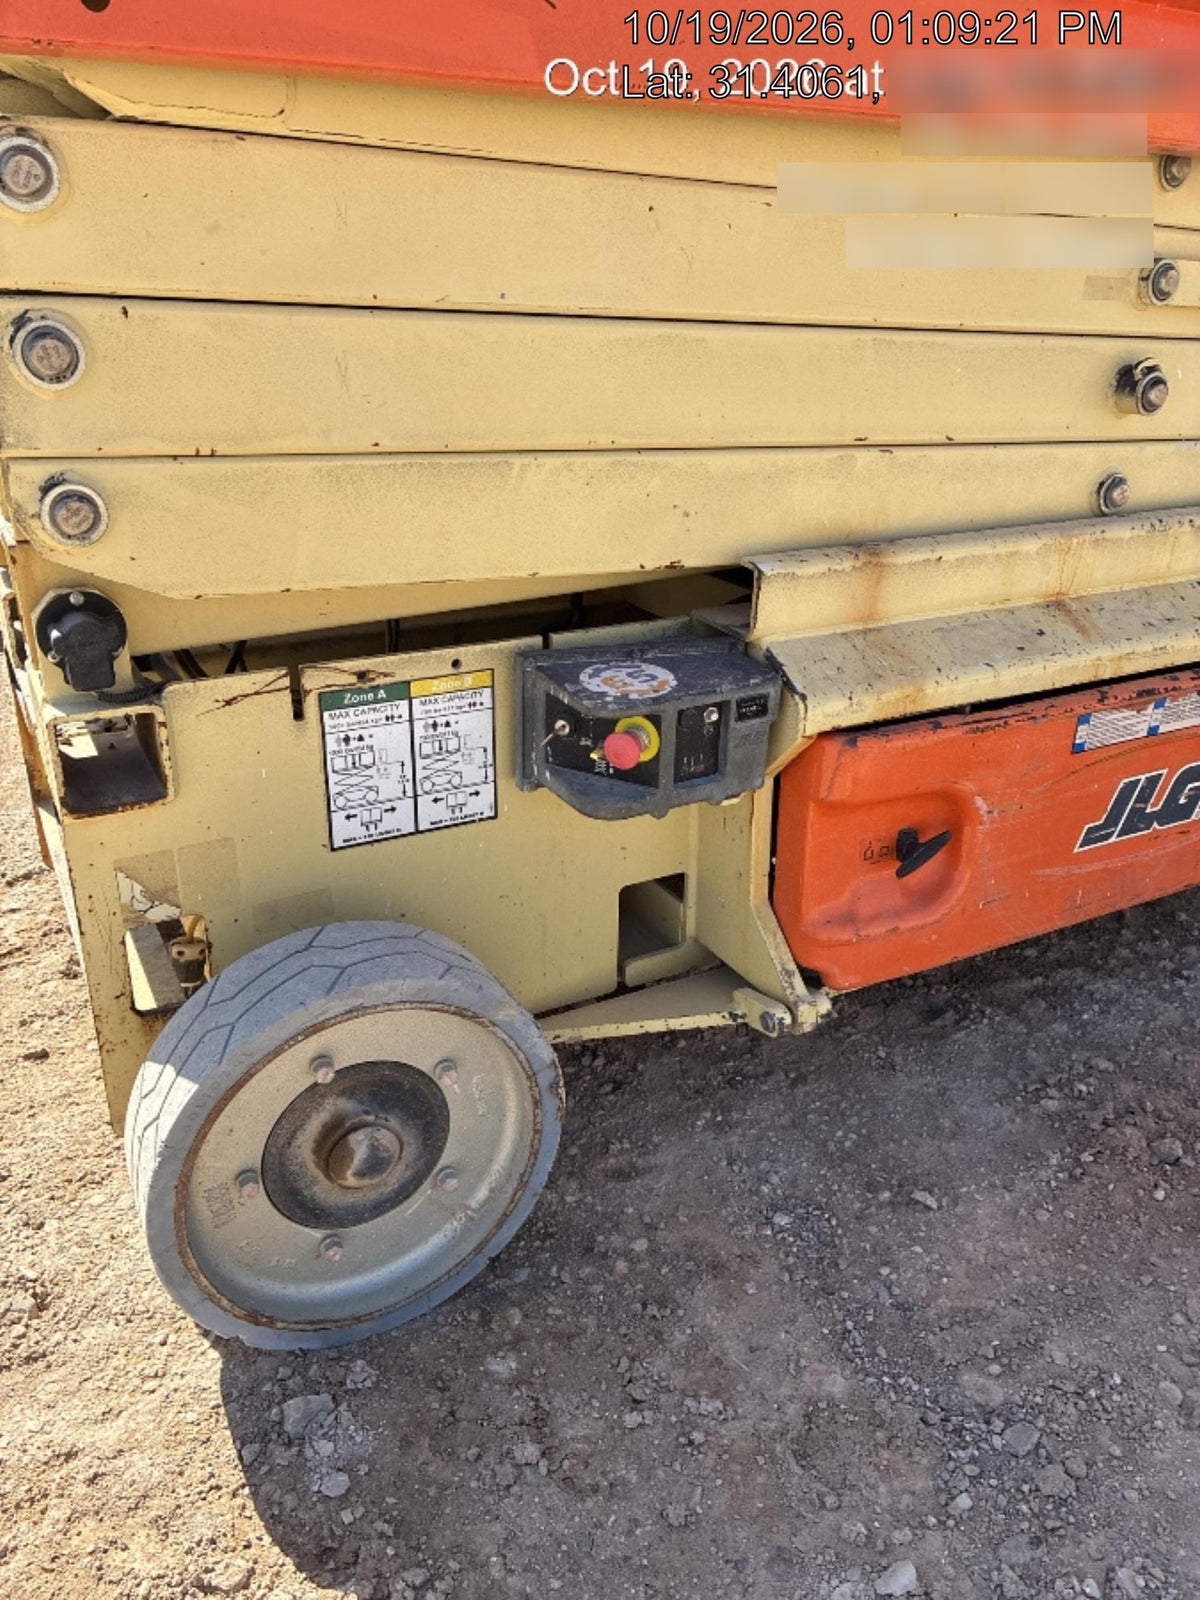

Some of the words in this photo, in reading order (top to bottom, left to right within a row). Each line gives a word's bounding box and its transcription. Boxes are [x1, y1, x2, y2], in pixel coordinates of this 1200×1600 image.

[431, 680, 461, 691] Zone
[343, 692, 374, 705] Zone
[377, 689, 387, 699] A
[419, 697, 440, 707] MAX
[442, 690, 484, 703] CAPACITY
[328, 710, 351, 721] MAX
[353, 703, 401, 718] CAPACITY
[1073, 761, 1200, 853] JLG
